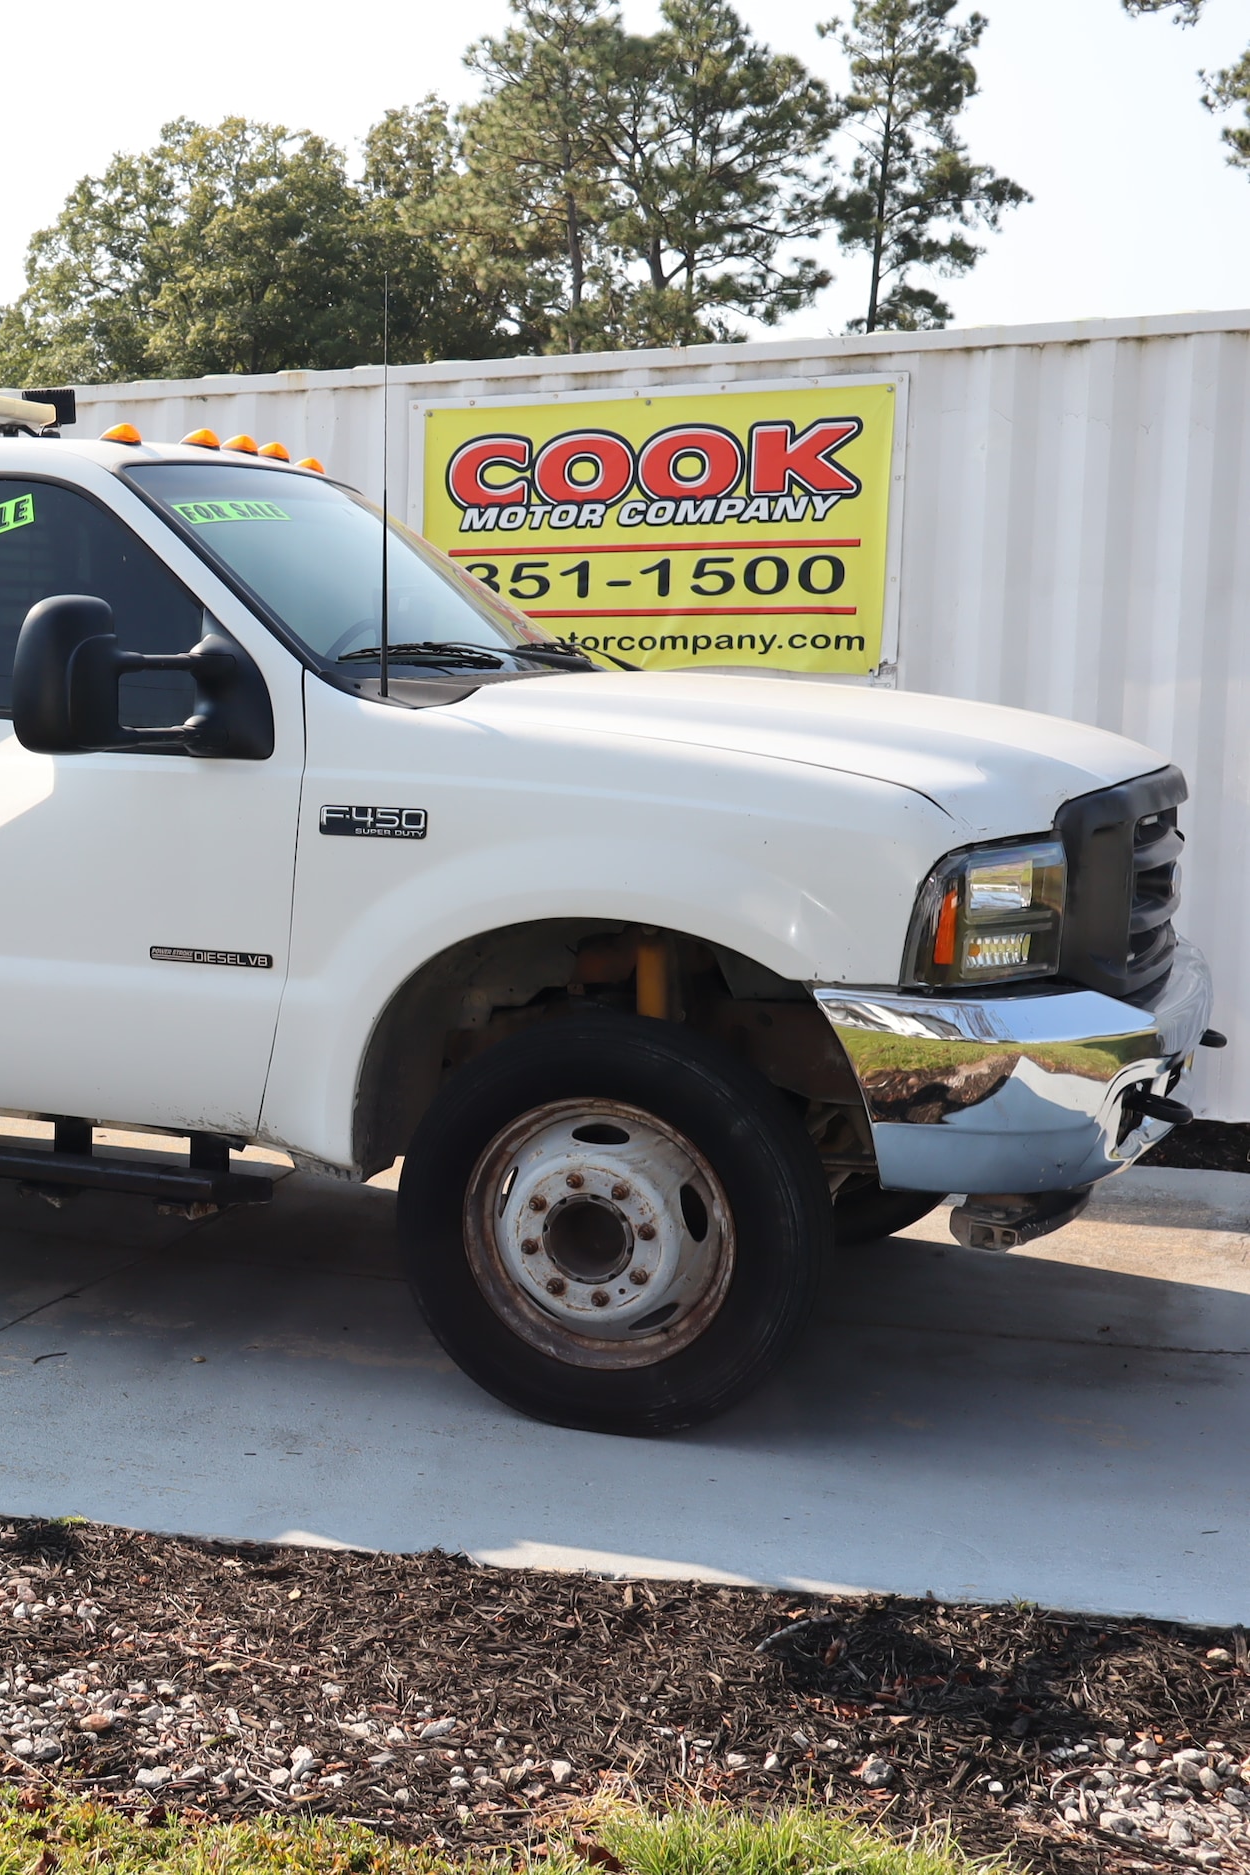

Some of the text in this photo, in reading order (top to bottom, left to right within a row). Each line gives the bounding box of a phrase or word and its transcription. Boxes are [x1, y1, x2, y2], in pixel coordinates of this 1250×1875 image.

[446, 416, 863, 508] COOK
[178, 502, 287, 521] FOR SALE
[460, 494, 842, 531] MOTOR COMPANY
[556, 631, 866, 656] torcompany.com
[321, 806, 425, 829] F-450
[355, 828, 424, 837] SUPER DUTY
[194, 951, 247, 965] DIESEL
[248, 954, 268, 966] V8
